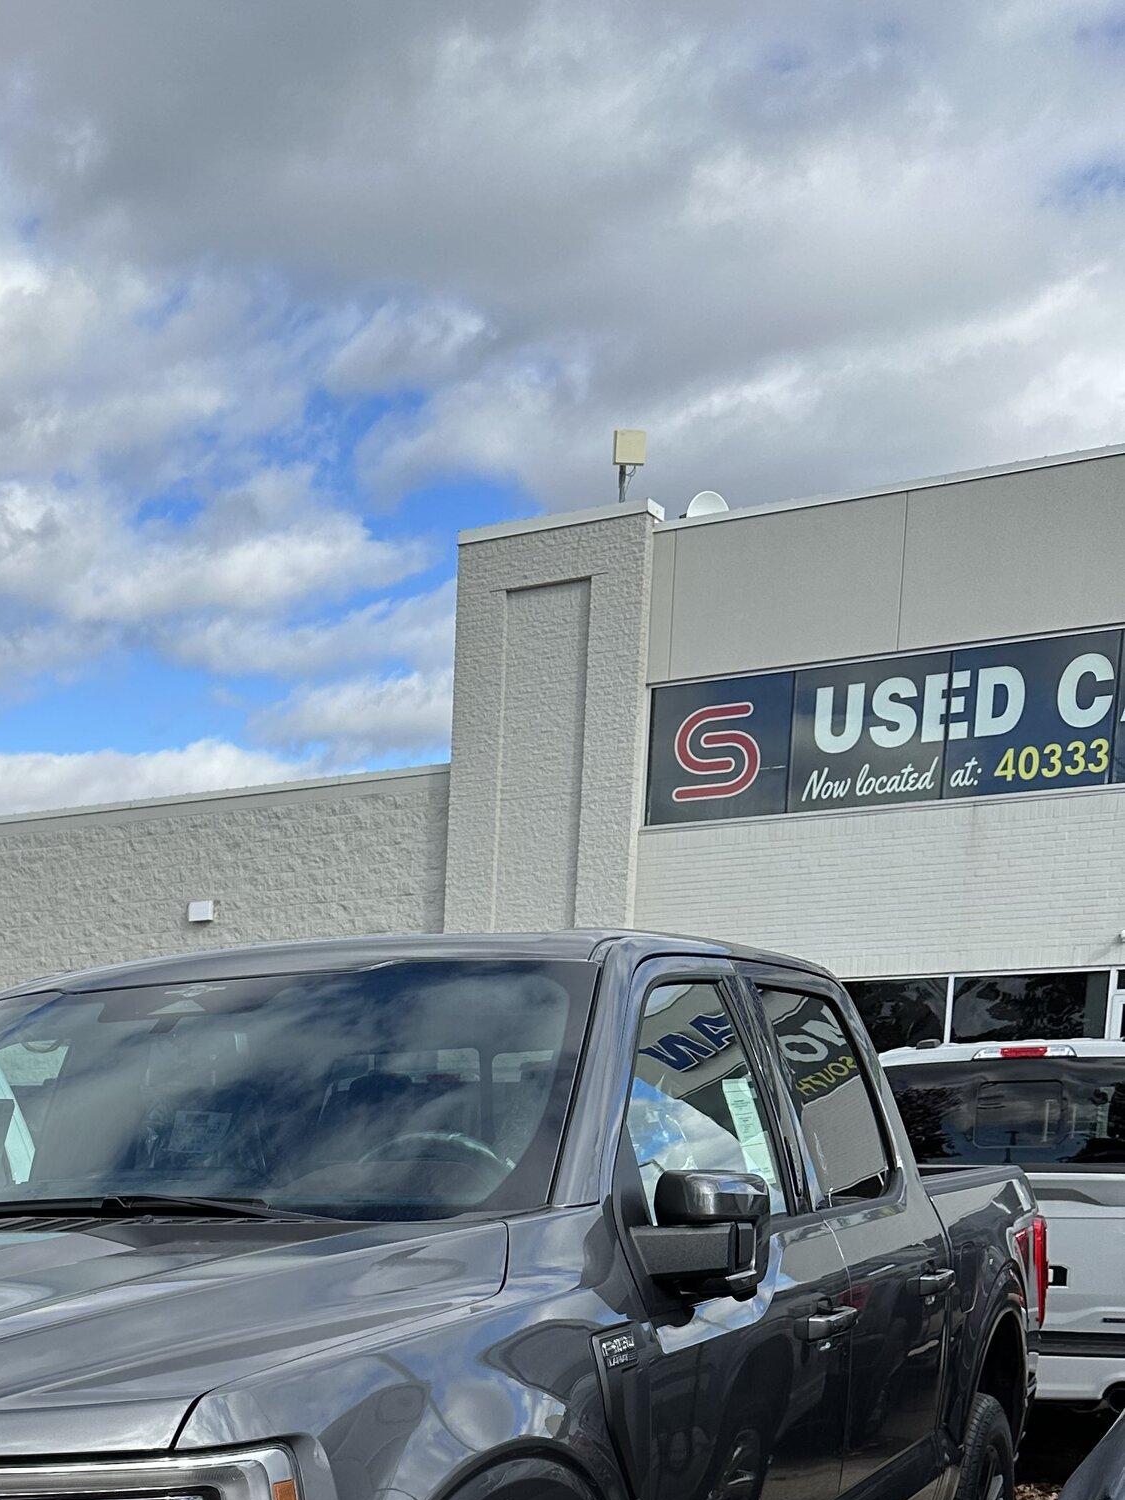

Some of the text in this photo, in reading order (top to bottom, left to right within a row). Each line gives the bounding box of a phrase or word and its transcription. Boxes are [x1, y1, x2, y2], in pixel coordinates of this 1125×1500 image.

[814, 652, 1125, 754] USED C
[801, 738, 1109, 801] Now located at: 40333
